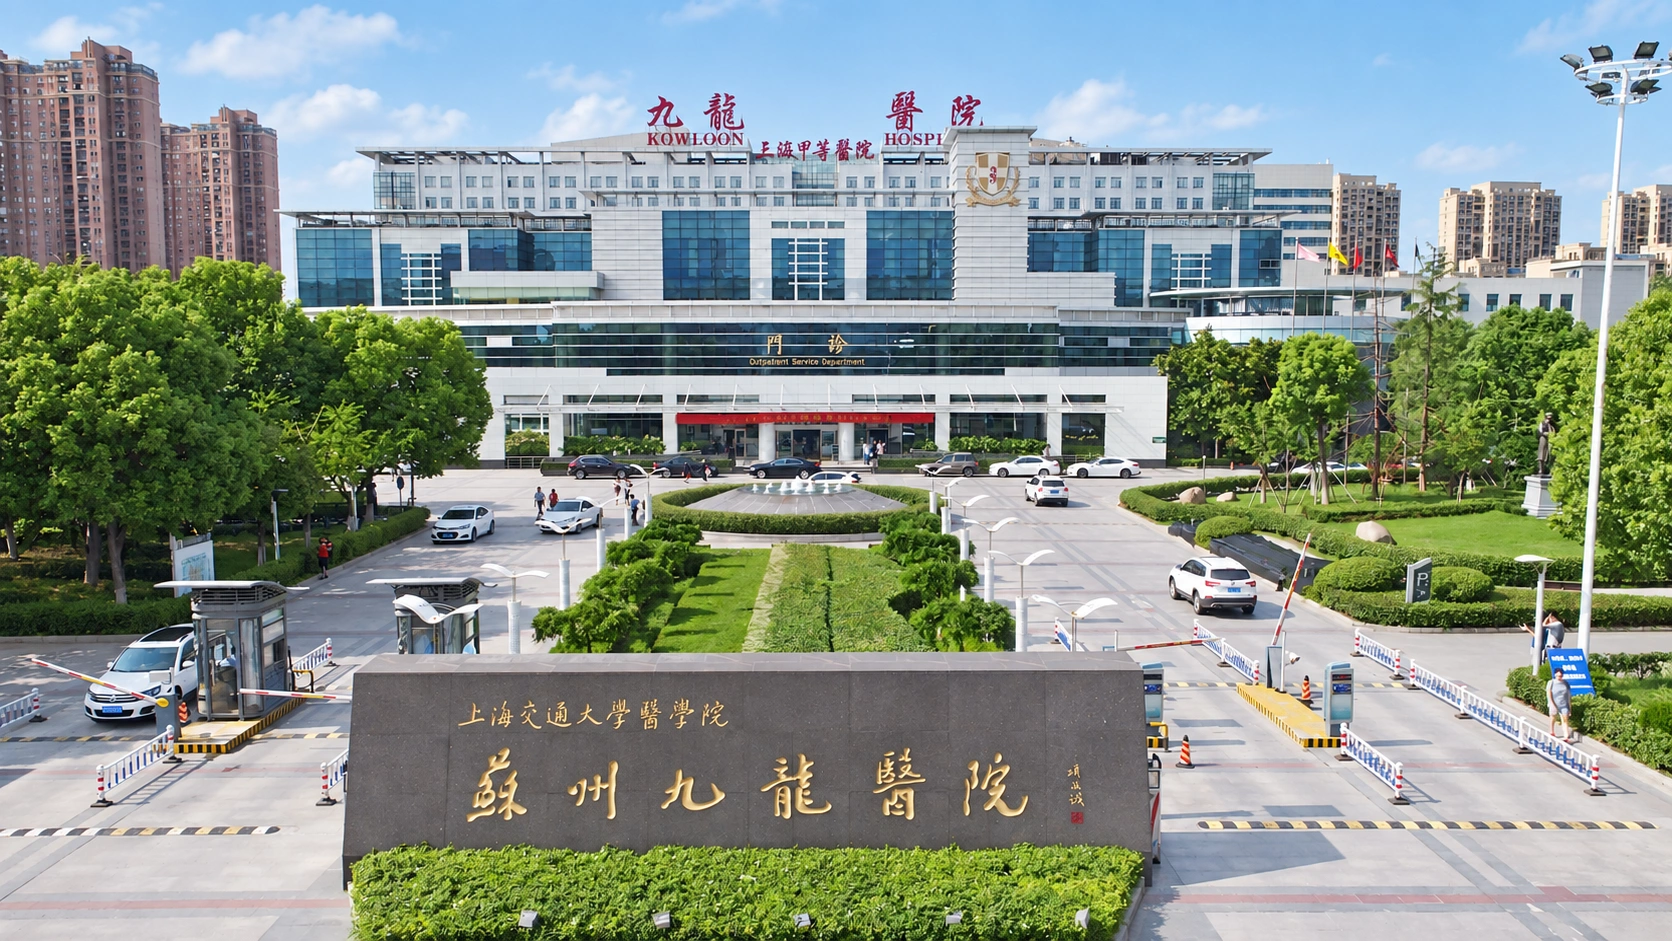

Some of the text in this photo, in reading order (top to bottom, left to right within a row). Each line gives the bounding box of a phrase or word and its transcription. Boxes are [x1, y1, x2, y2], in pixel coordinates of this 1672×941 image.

[646, 90, 984, 132] 九龍 醫院
[647, 132, 744, 146] KOWLOON
[792, 358, 819, 366] Service
[821, 358, 866, 367] Department
[1417, 572, 1429, 587] P
[458, 698, 729, 730] 上海交通大學醫學院
[466, 747, 1029, 823] 蘇州九龍醫院
